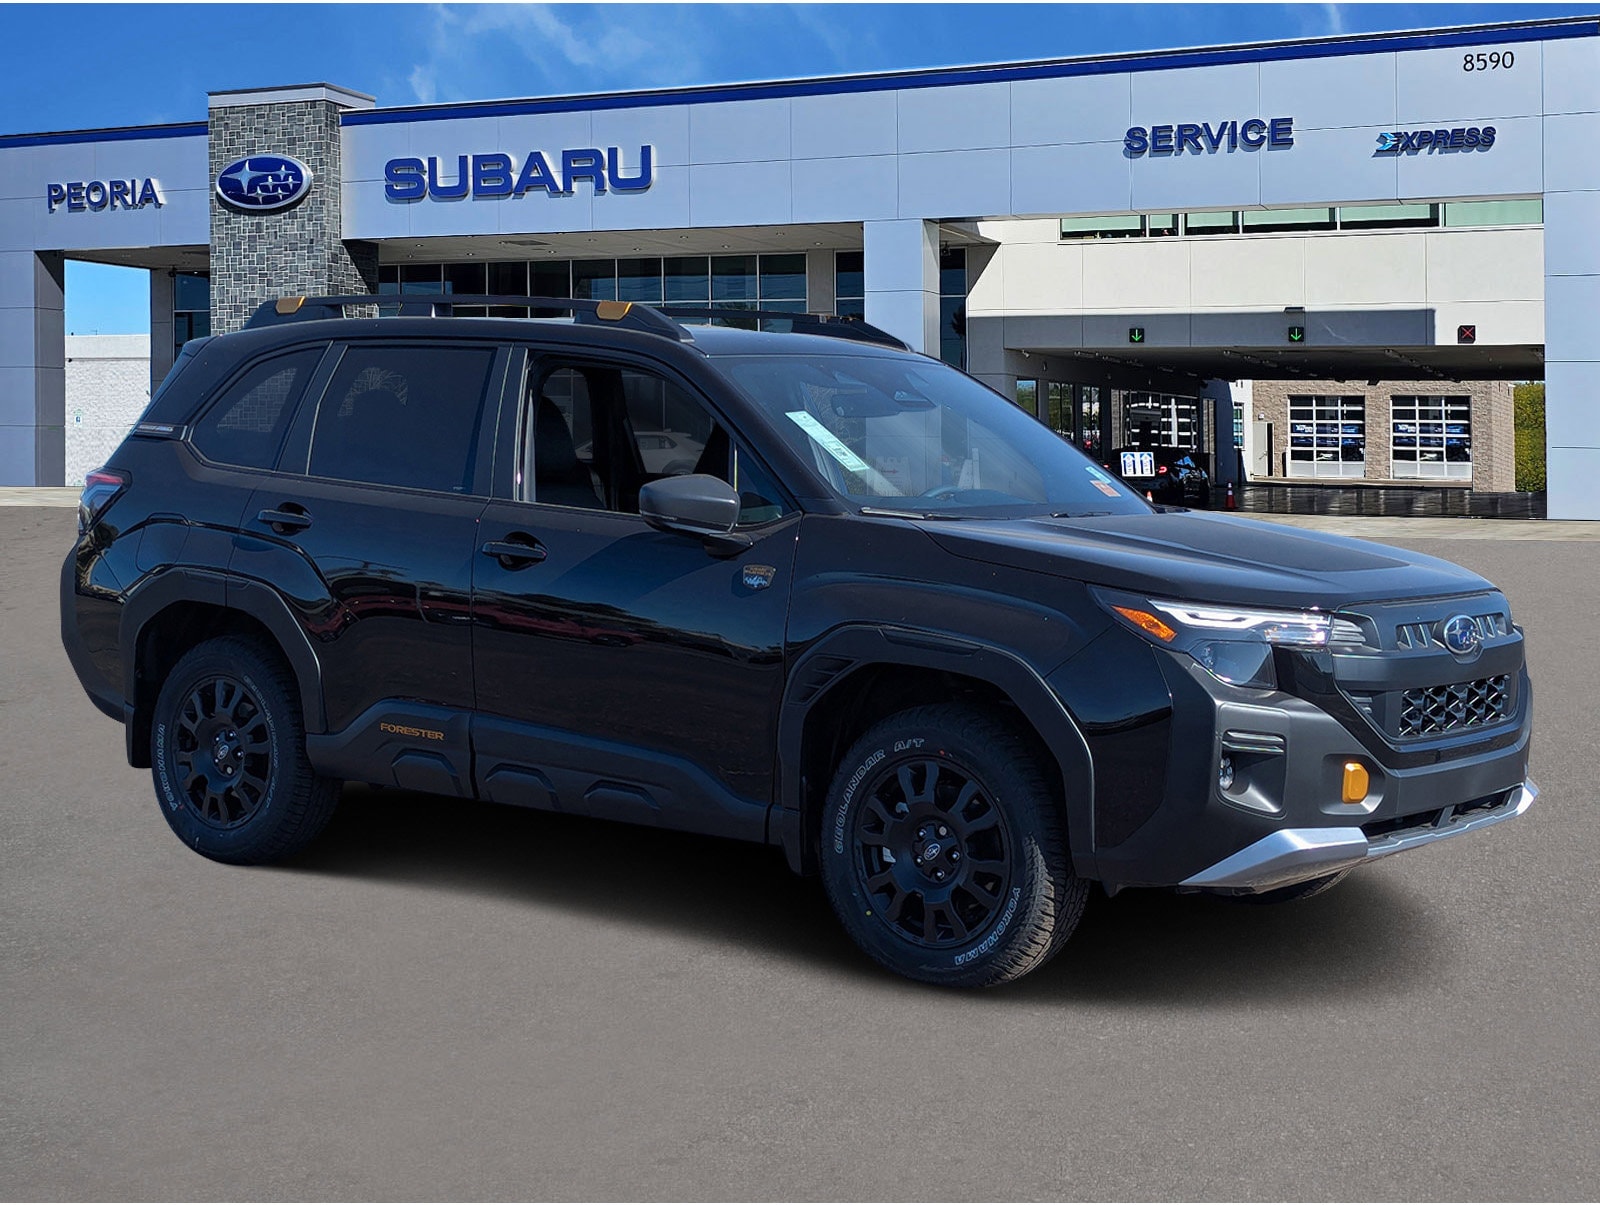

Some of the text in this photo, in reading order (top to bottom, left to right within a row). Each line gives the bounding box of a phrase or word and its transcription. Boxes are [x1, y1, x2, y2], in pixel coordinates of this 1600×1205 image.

[1463, 51, 1514, 71] 8590
[1125, 117, 1294, 154] SERVICE
[1375, 126, 1497, 152] EXPRESS
[384, 145, 652, 200] SUBARU
[47, 178, 162, 211] PEORIA
[380, 722, 445, 740] FORESTER
[834, 738, 925, 854] GEOLANDAR A/T
[954, 887, 1021, 965] YOKOHAMA
